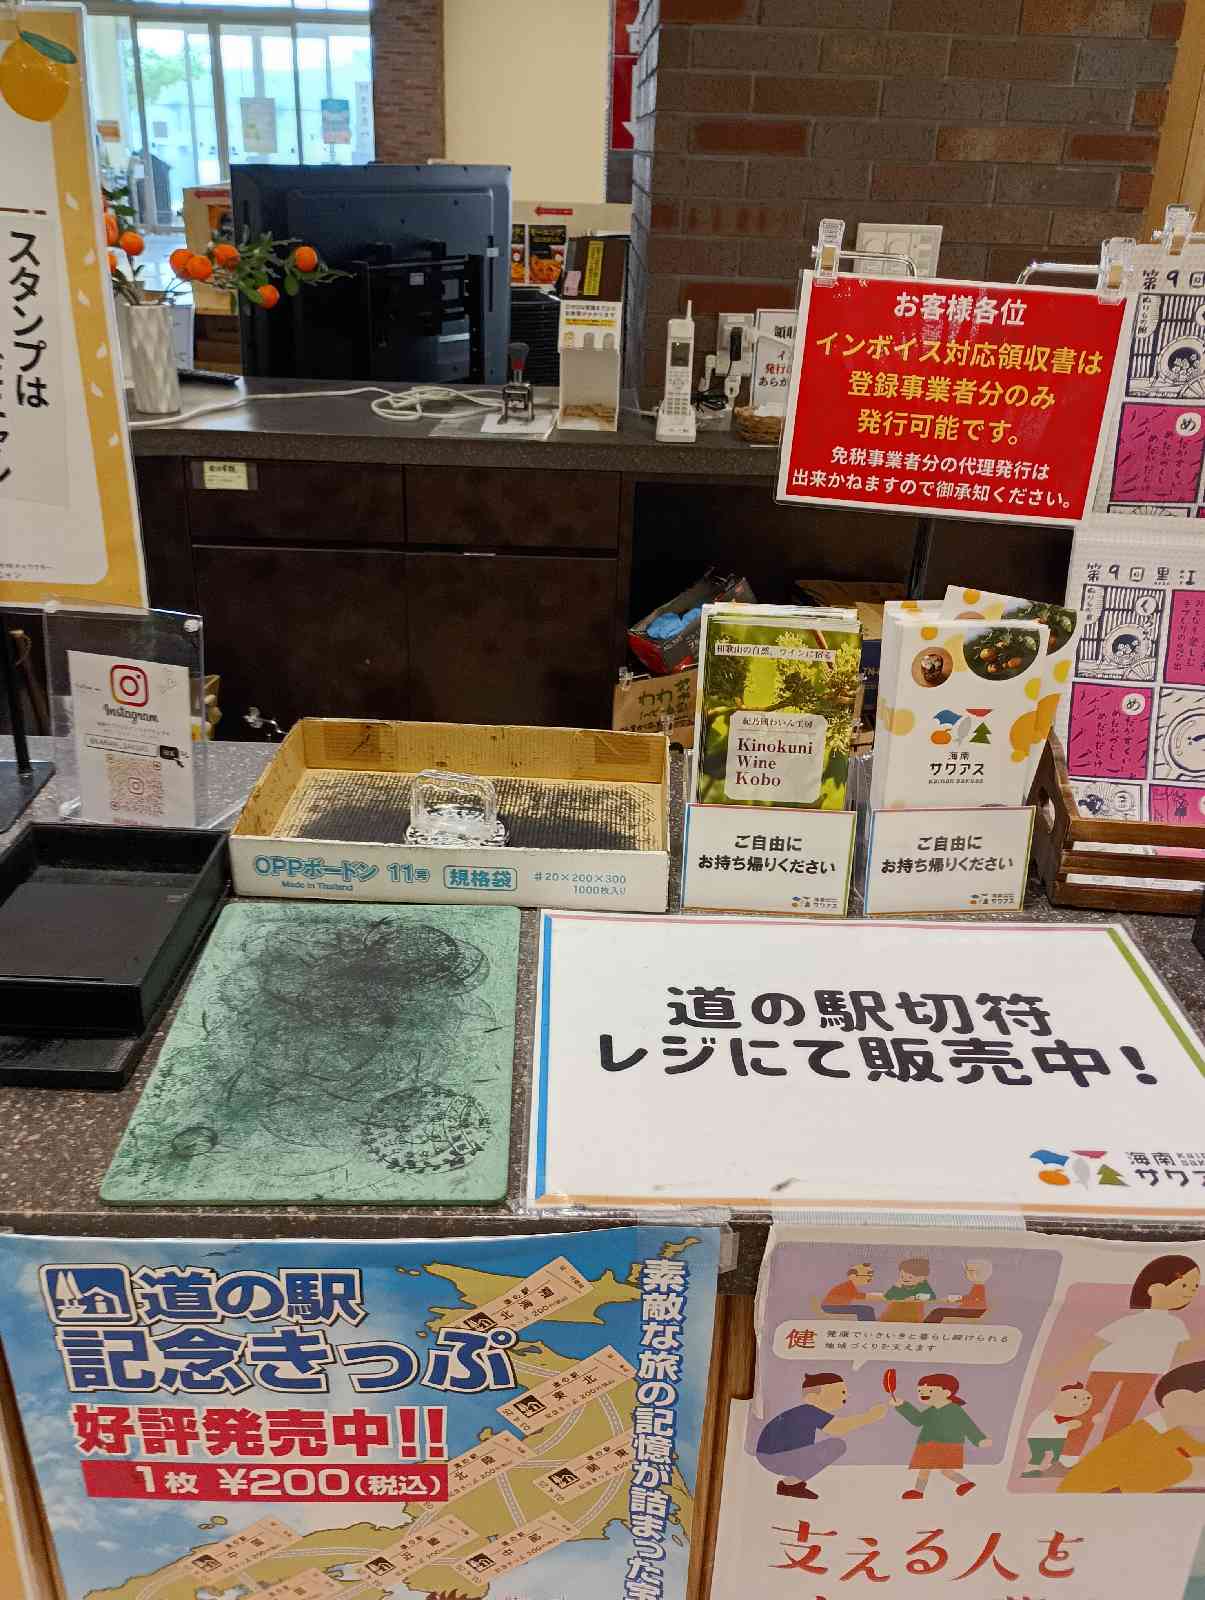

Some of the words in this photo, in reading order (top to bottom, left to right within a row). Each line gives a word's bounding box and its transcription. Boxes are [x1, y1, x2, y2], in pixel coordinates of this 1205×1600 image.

[8, 231, 50, 408] スタンプは
[893, 290, 1028, 327] お客様各位
[815, 332, 1104, 376] インボイス対応領収書は
[848, 370, 1057, 411] 登録事業者分のみ
[857, 408, 1019, 447] 発行可能です。
[829, 446, 1051, 481] 免税事業者分の代理発行は
[791, 468, 1073, 510] 出来かねますので御承知ください。
[104, 704, 159, 724] Instagram
[736, 738, 814, 756] Kinokuni
[736, 755, 778, 770] Wine
[735, 771, 782, 787] Kobo
[733, 834, 803, 852] ご自由に
[916, 836, 983, 852] ご自由に
[449, 868, 513, 889] 規格袋
[698, 854, 836, 875] お持ち帰りください
[880, 858, 1015, 875] お持ち帰りください
[573, 884, 627, 896] 1000枚入り
[664, 986, 1052, 1038] 道の駅切符
[598, 1034, 1159, 1089] レジにて販売中!
[1125, 1151, 1177, 1167] 海南
[136, 1266, 369, 1326] 道の駅
[785, 1328, 817, 1349] 健
[56, 1325, 518, 1393] 記念きっぷ
[73, 1404, 448, 1460] 好評発売中!!
[136, 1465, 199, 1495] 1枚
[768, 1520, 1085, 1583] 支える人を
